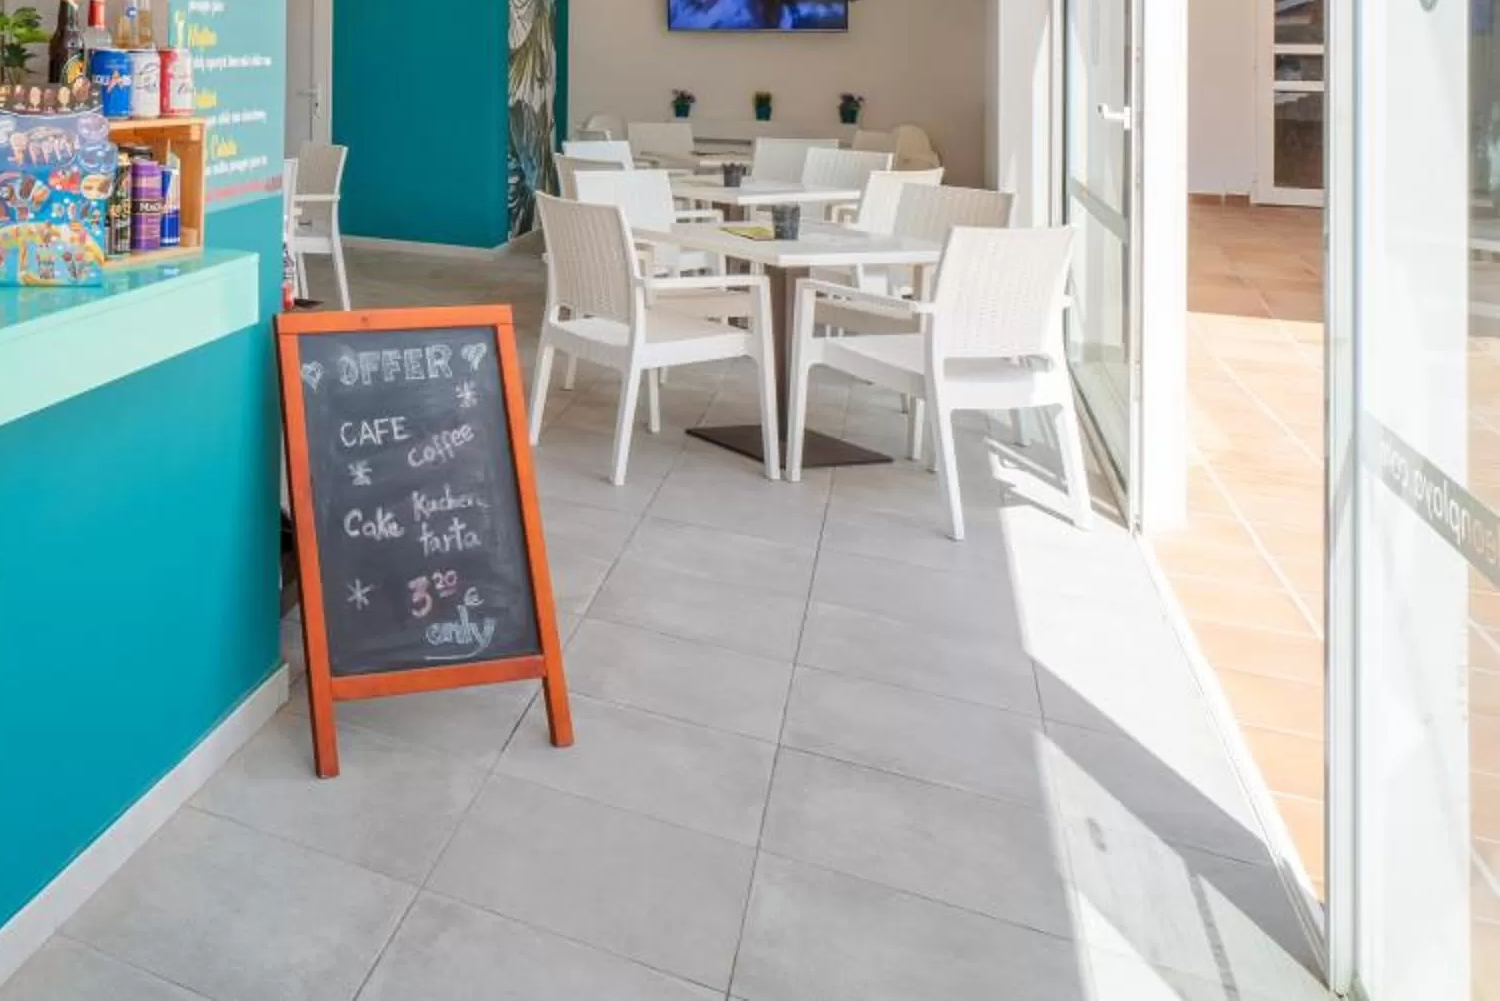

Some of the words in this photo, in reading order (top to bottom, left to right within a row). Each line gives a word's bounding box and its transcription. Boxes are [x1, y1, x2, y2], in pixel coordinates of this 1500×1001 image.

[338, 343, 453, 386] OFFER
[339, 416, 412, 448] CAFE
[343, 506, 405, 541] Cake
[419, 516, 483, 557] tarta
